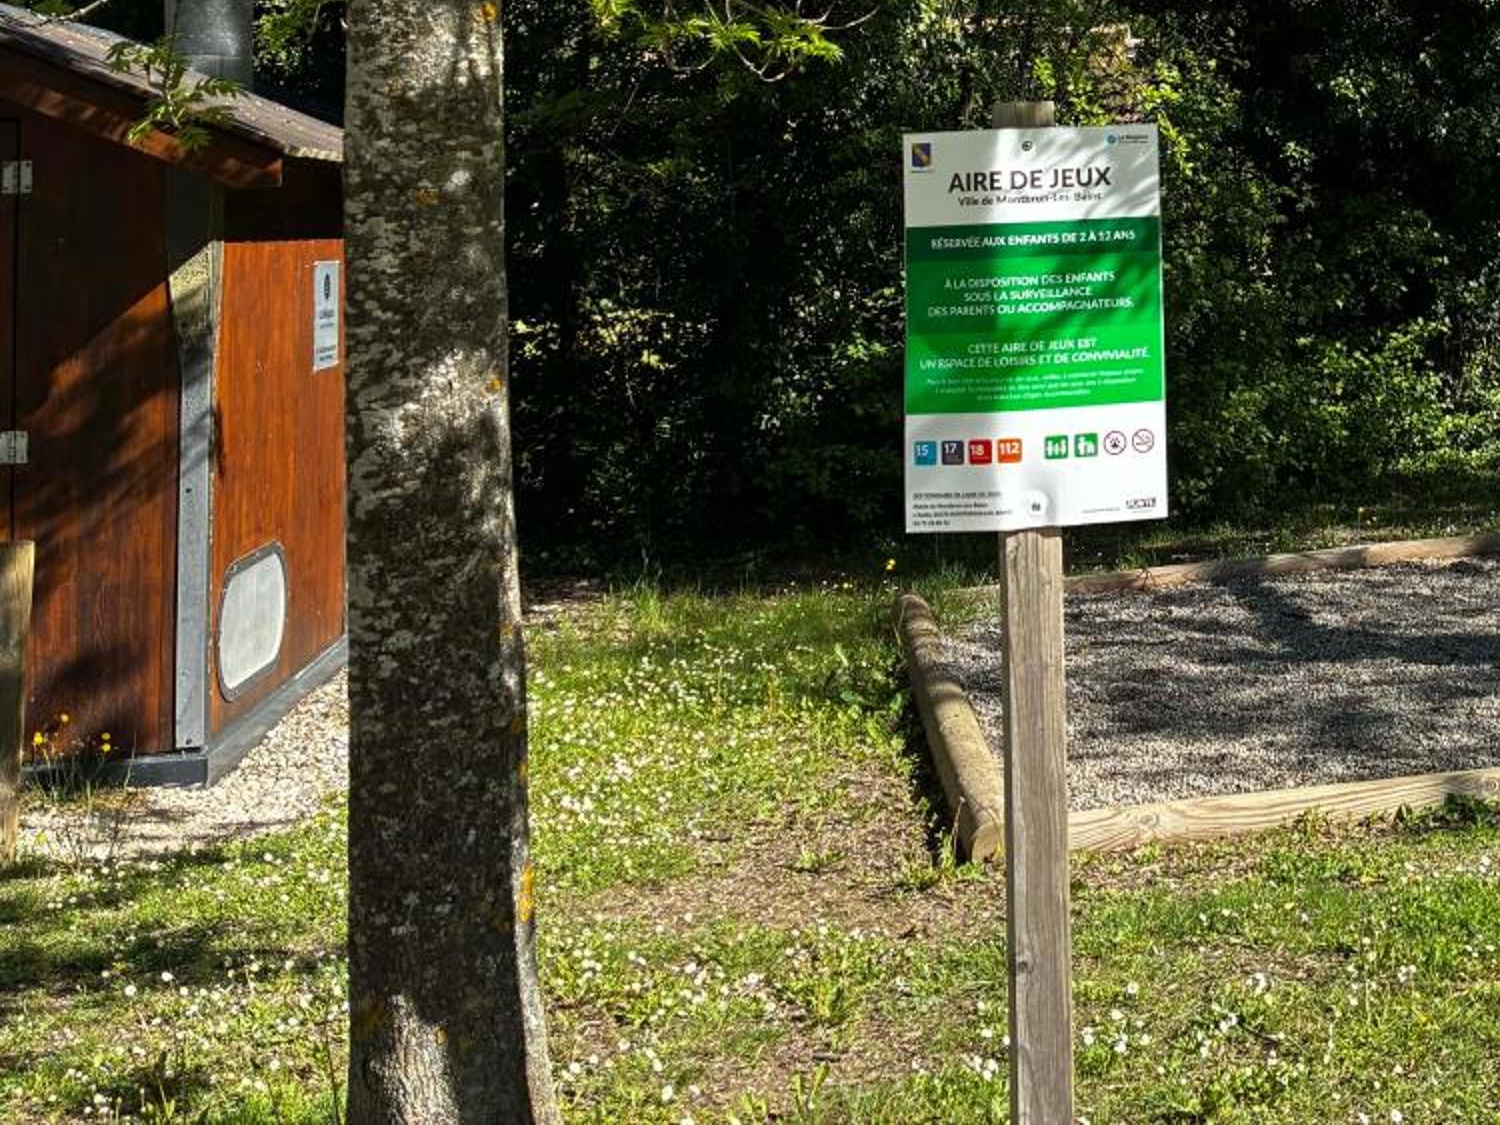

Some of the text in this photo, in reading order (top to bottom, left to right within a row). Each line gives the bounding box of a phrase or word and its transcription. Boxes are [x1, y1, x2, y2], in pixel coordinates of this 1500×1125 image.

[949, 166, 1112, 193] AIRE DE JEUX
[957, 196, 979, 207] Ville
[981, 195, 993, 206] de
[931, 235, 982, 250] RÉSERVÉE
[982, 235, 1006, 248] AUX
[1007, 232, 1059, 247] ENFANTS
[1061, 231, 1078, 245] DE
[1079, 231, 1088, 243] 2
[1113, 228, 1137, 241] ANS
[953, 277, 967, 290] LA
[968, 276, 1039, 289] DISPOSITION
[1041, 273, 1063, 286] DES
[1065, 271, 1116, 284] ENFANTS
[963, 286, 1092, 302] SOUS LA SURVEILLANCE
[927, 305, 949, 317] DES
[949, 303, 995, 317] PARENTS
[997, 302, 1016, 315] OU
[968, 337, 1097, 354] CETTE AIRE DE JEUX EST
[919, 358, 937, 370] UN
[937, 356, 976, 370] ESPACE
[977, 356, 992, 368] DE
[993, 354, 1036, 367] LOISIRS
[1038, 353, 1051, 365] ET
[1053, 351, 1069, 364] DE
[916, 442, 1021, 456] 15 17 18 112
